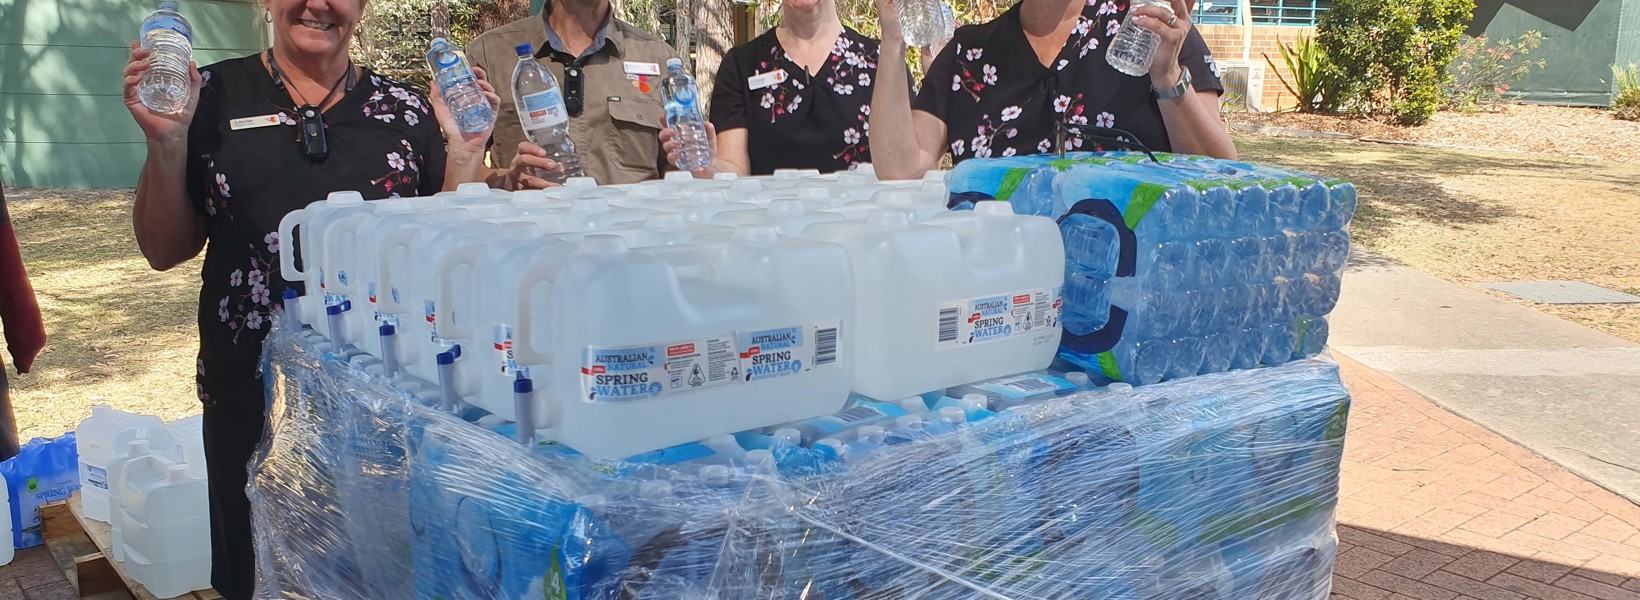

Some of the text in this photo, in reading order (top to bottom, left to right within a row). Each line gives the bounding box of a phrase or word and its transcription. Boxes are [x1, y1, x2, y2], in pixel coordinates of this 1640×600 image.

[974, 300, 1004, 311] AUSTRALIAN
[981, 307, 1004, 316] NATURAL
[974, 316, 1004, 330] SPRING
[974, 325, 1004, 338] WATER
[752, 332, 792, 345] AUSTRALIAN
[760, 340, 791, 351] NATURAL
[595, 352, 649, 363] AUSTRALIAN
[752, 350, 792, 366] SPRING
[607, 360, 648, 371] NATURAL
[752, 360, 791, 376] WATER
[596, 372, 649, 386] SPRING
[596, 383, 649, 397] WATER
[35, 487, 66, 500] SPRING
